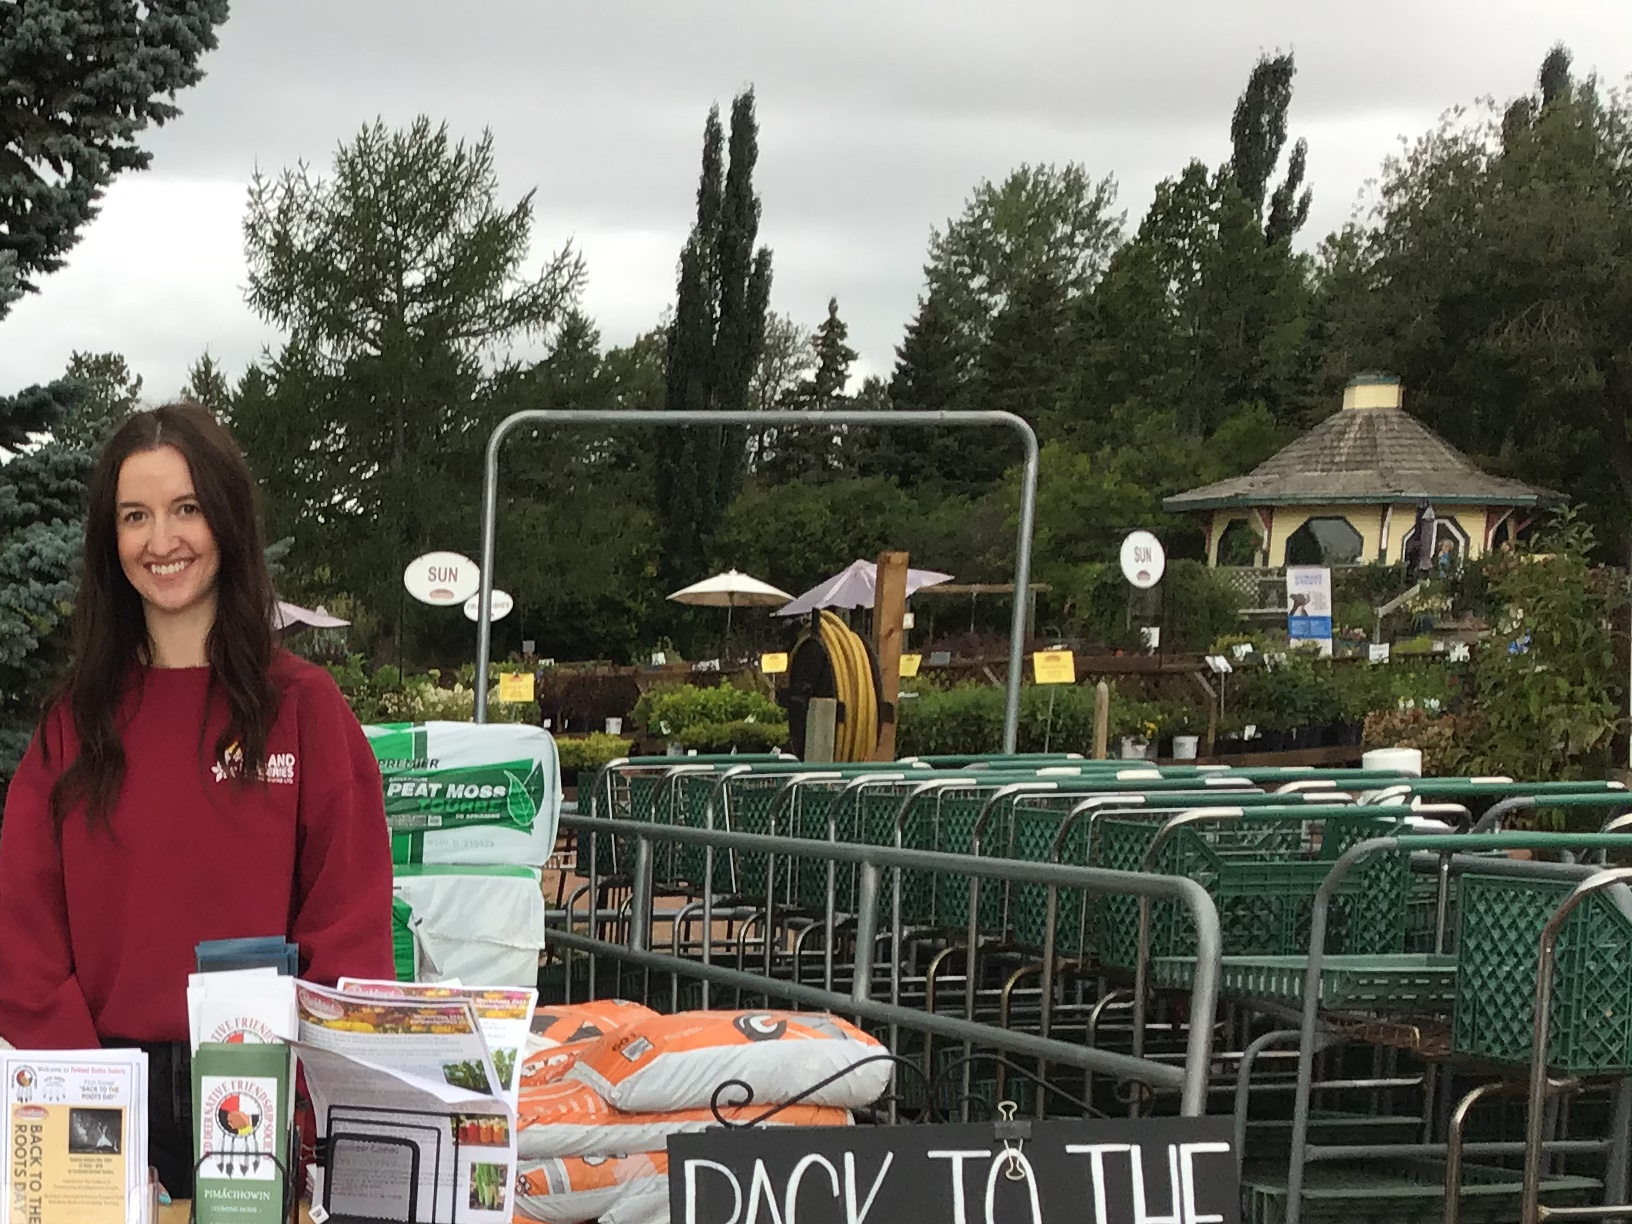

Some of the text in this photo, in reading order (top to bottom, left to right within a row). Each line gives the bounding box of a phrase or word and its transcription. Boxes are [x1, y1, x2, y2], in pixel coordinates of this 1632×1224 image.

[1134, 546, 1152, 563] SUN
[428, 566, 458, 583] SUN
[378, 757, 440, 769] PREMIER
[387, 783, 507, 799] PEAT MOSS
[204, 1081, 232, 1116] NATIVE
[14, 1124, 27, 1215] ROOTS DAY
[28, 1124, 43, 1224] BACK TO THE
